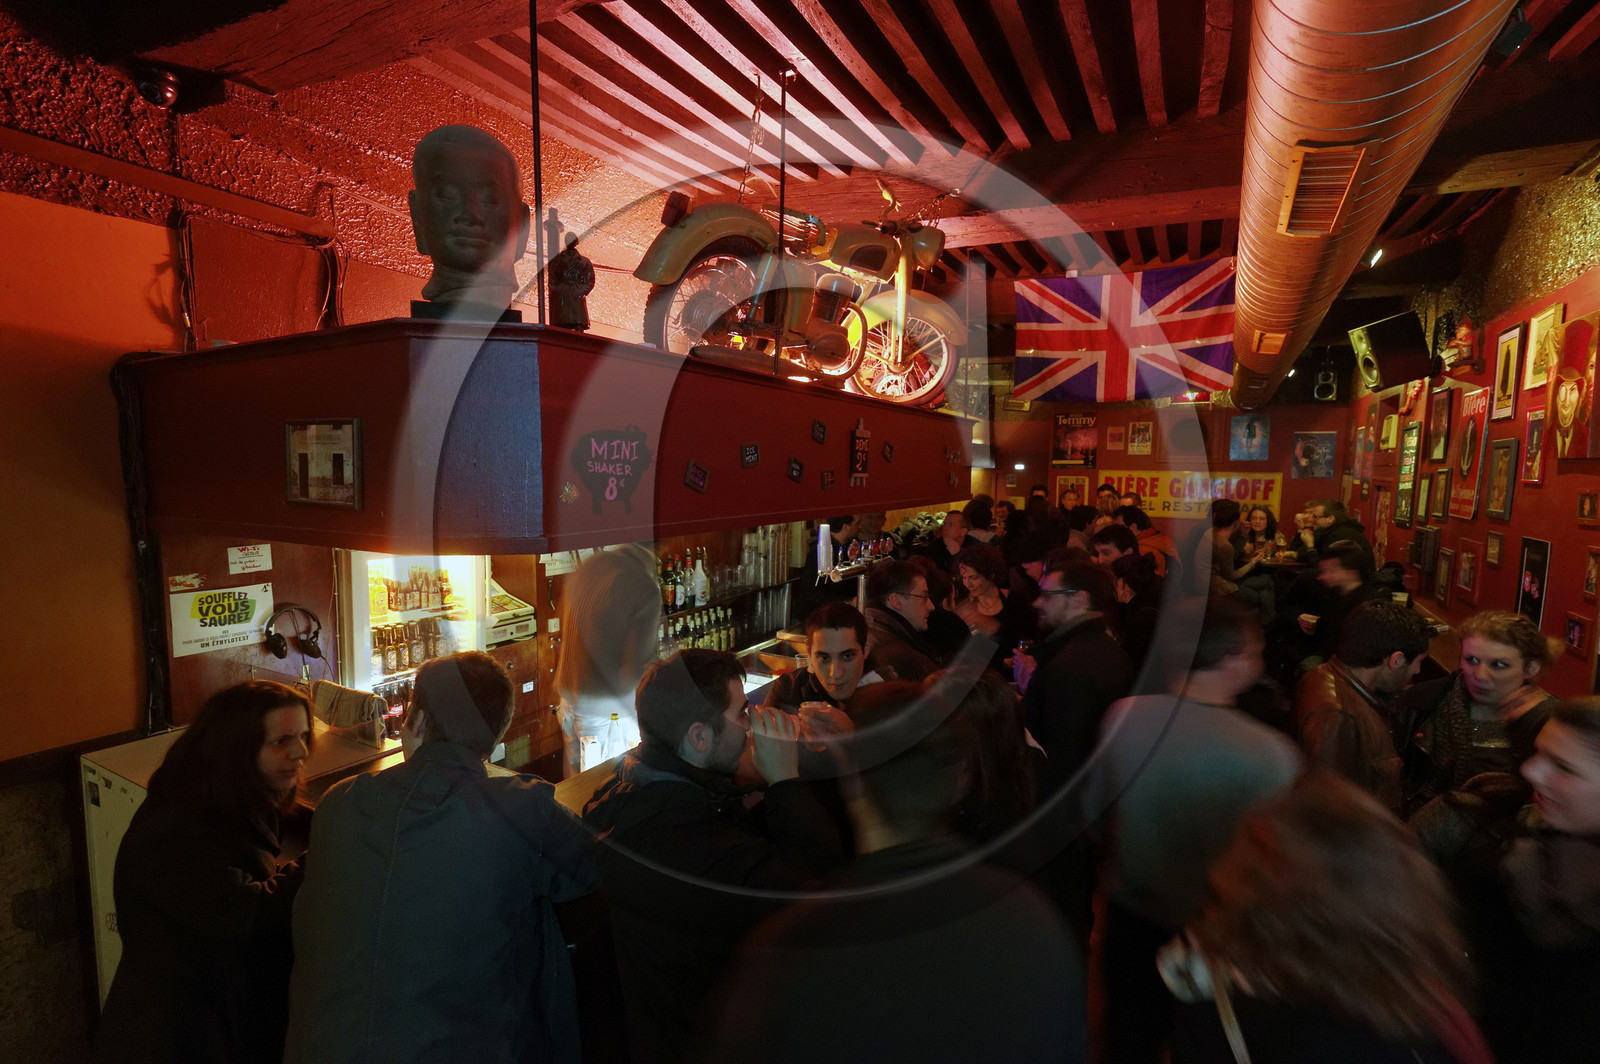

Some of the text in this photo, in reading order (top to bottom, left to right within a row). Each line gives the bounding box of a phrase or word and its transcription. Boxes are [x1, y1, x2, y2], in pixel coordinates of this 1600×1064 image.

[1462, 394, 1486, 417] Bière
[1056, 414, 1096, 427] Tommy
[591, 437, 639, 461] MINI
[746, 446, 756, 455] ICE
[745, 453, 758, 463] MINT
[586, 460, 633, 476] SHAKER
[1169, 476, 1275, 501] GANGLOFF
[198, 591, 248, 606] SOUFFLEZ
[198, 600, 250, 617] VOUS
[199, 612, 250, 628] SAUREZ
[211, 635, 249, 646] ÉTHYLOTEST
